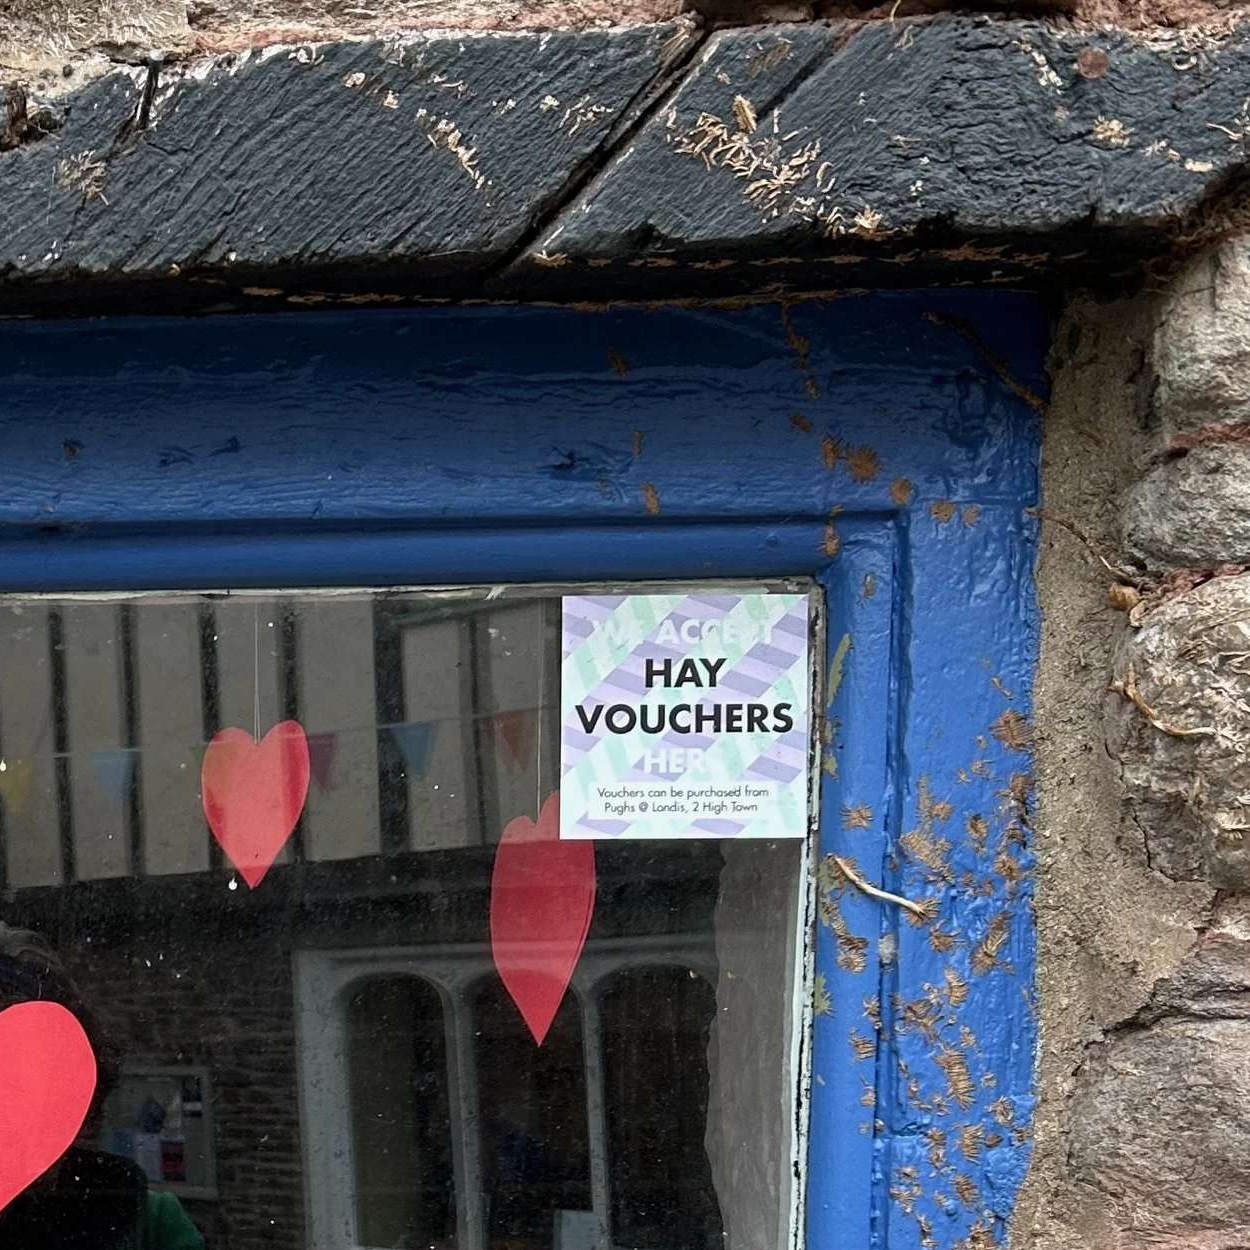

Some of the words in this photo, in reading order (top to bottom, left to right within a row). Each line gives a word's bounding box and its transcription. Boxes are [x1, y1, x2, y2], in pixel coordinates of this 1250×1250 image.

[654, 618, 772, 646] ACCET
[644, 657, 728, 689] HAY
[574, 702, 795, 735] VOUCHERS
[643, 747, 724, 774] HER
[597, 785, 645, 798] Vouchers
[647, 789, 667, 798] can
[669, 784, 684, 798] be
[686, 784, 741, 801] purchased
[744, 783, 770, 798] from
[604, 800, 636, 816] Pughs
[638, 801, 649, 812] @
[692, 801, 700, 812] 2
[702, 800, 728, 815] High
[730, 801, 758, 813] Town
